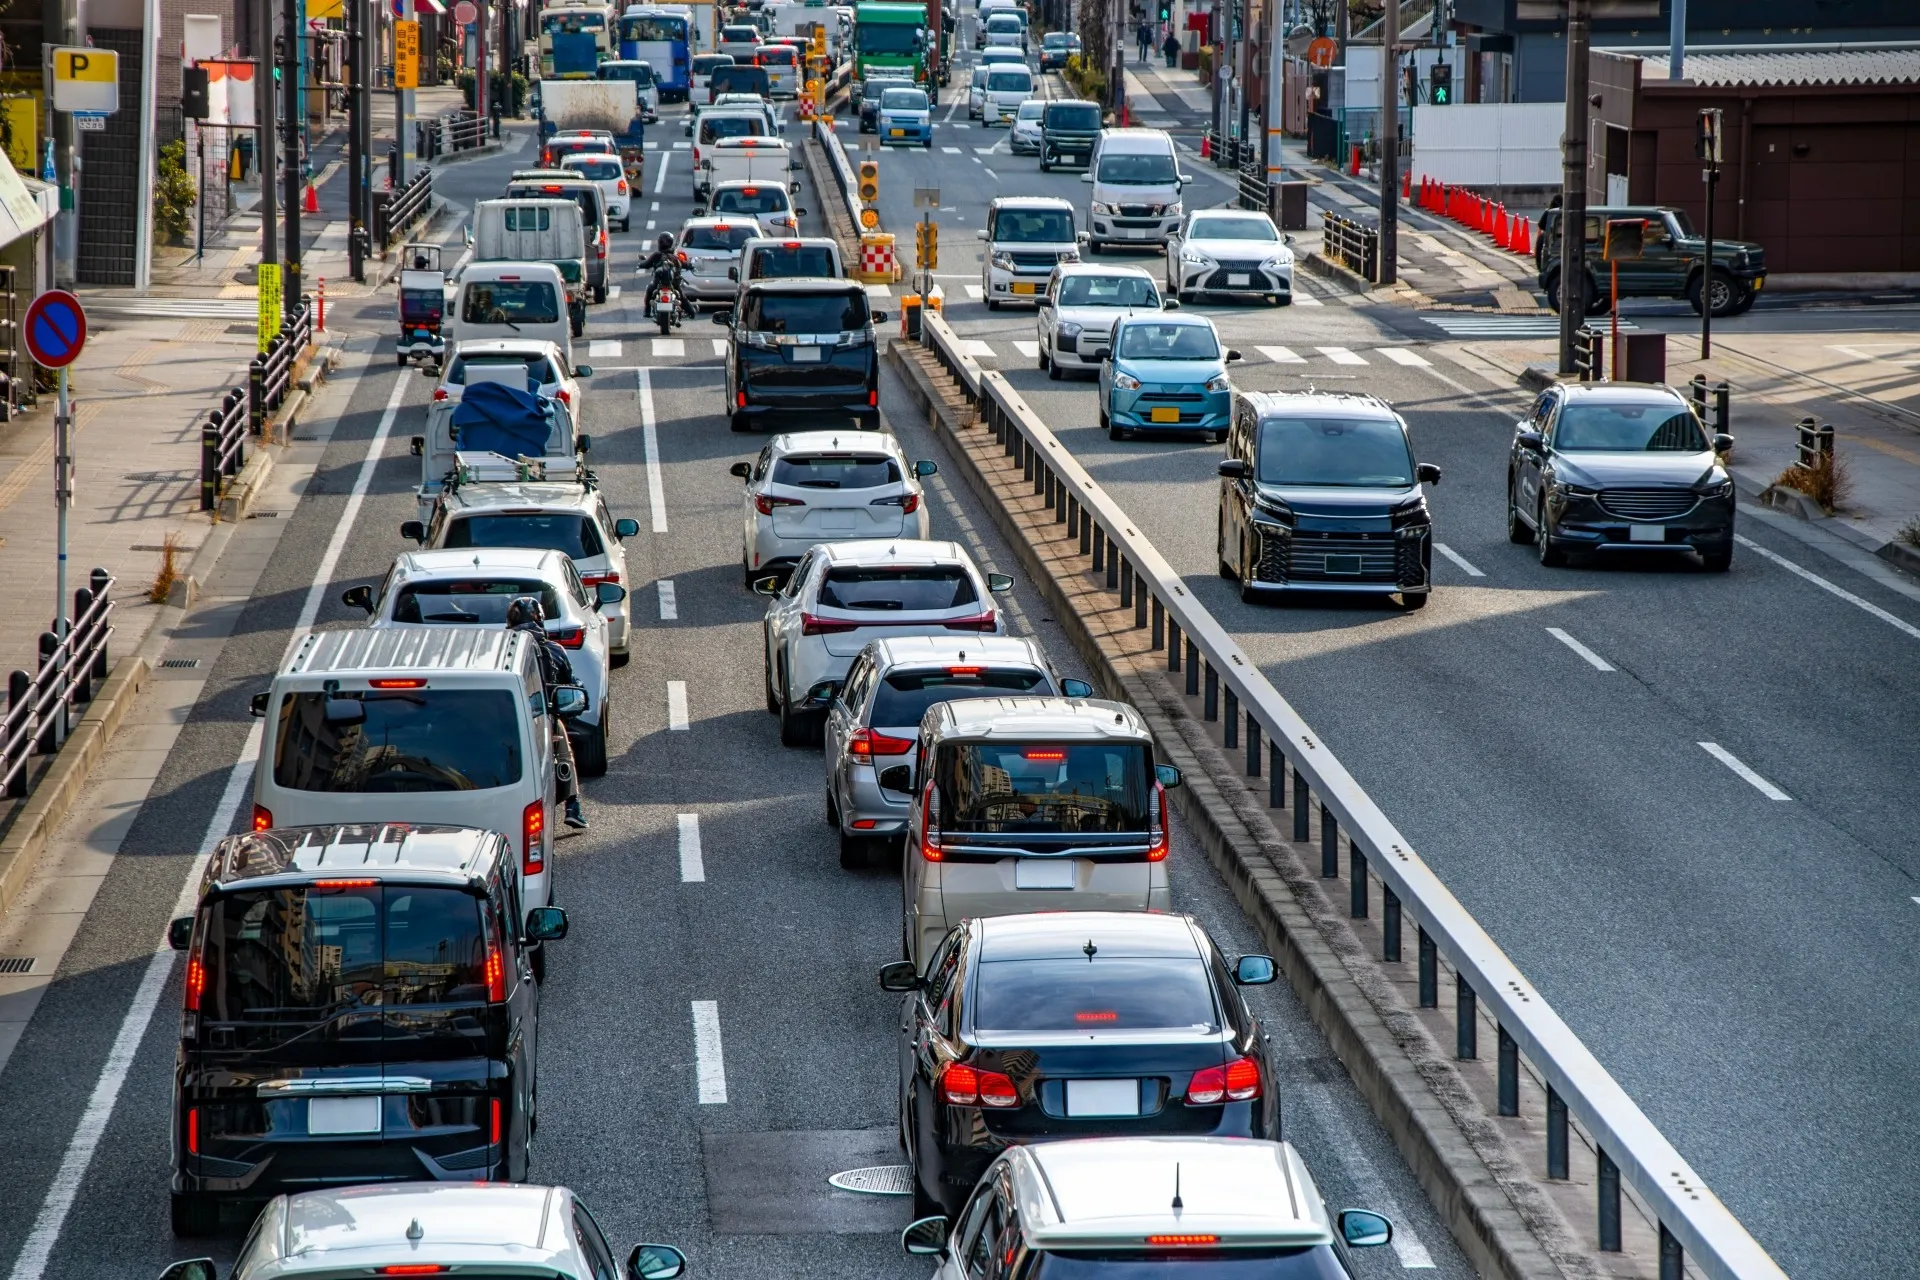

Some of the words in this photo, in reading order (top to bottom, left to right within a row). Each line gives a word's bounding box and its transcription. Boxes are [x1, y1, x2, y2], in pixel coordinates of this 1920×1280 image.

[397, 28, 407, 84] 自転車注意
[407, 23, 417, 56] 歩行者
[70, 53, 89, 79] P
